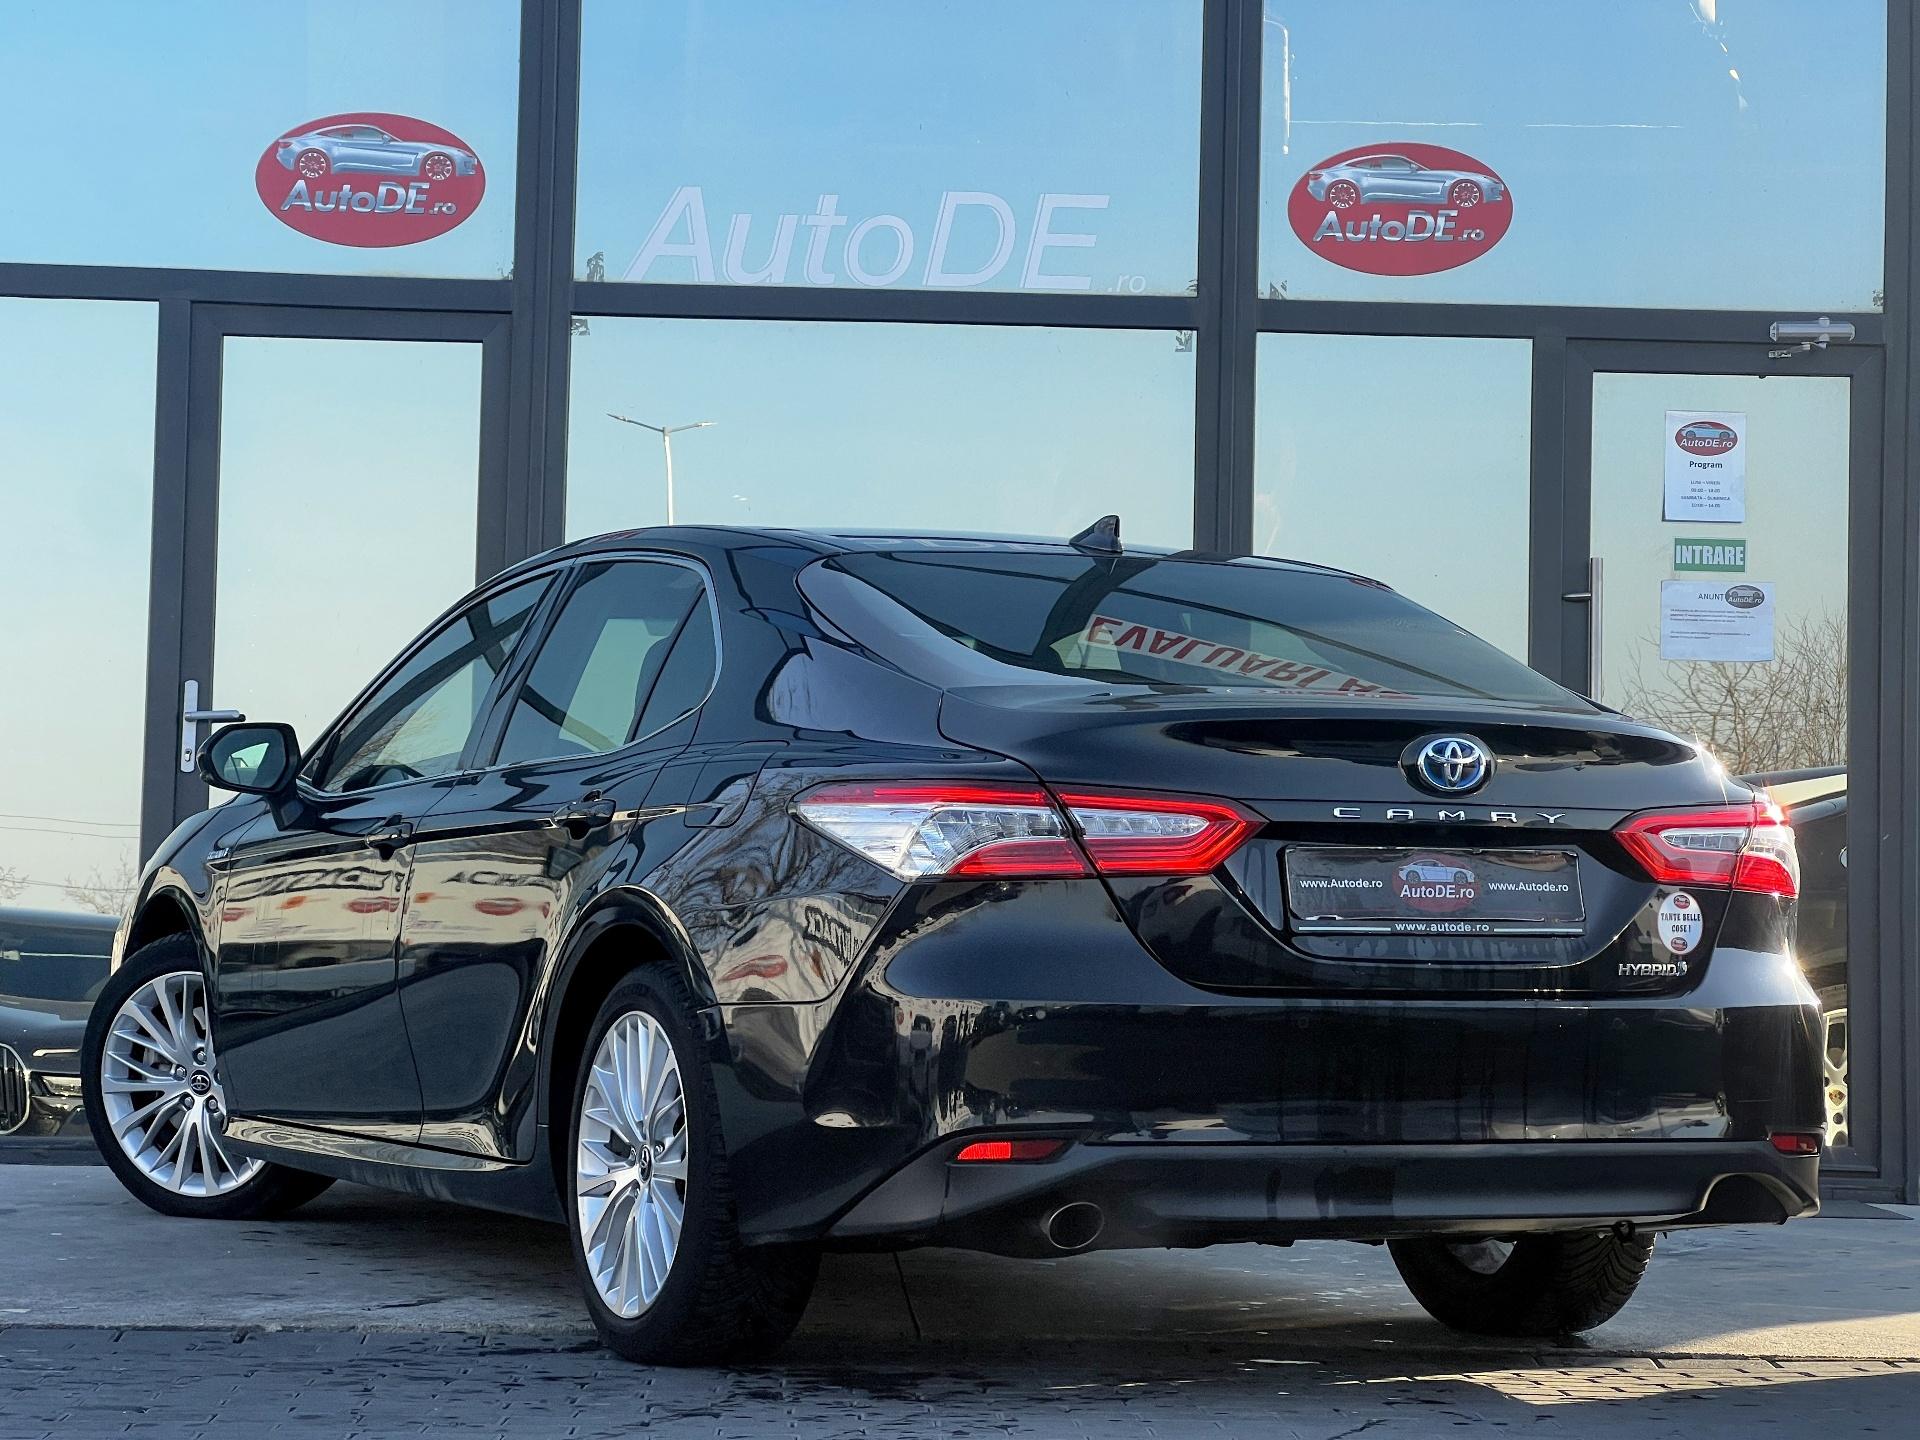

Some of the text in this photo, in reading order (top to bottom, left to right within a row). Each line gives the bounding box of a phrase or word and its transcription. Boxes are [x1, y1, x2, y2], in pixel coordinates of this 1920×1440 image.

[1680, 438, 1733, 448] AutoDE.ro
[1689, 460, 1723, 469] Program
[1675, 545, 1745, 566] INTRARE
[1333, 807, 1566, 824] CAMRY
[1300, 878, 1383, 889] www.Autode.ro
[1488, 881, 1569, 892] www.Autode.ro
[1400, 884, 1475, 899] AutoDE.ro
[1661, 912, 1701, 922] TANTE BELLE
[1394, 922, 1490, 932] www.autode.ro
[1618, 963, 1677, 977] HYBRID
